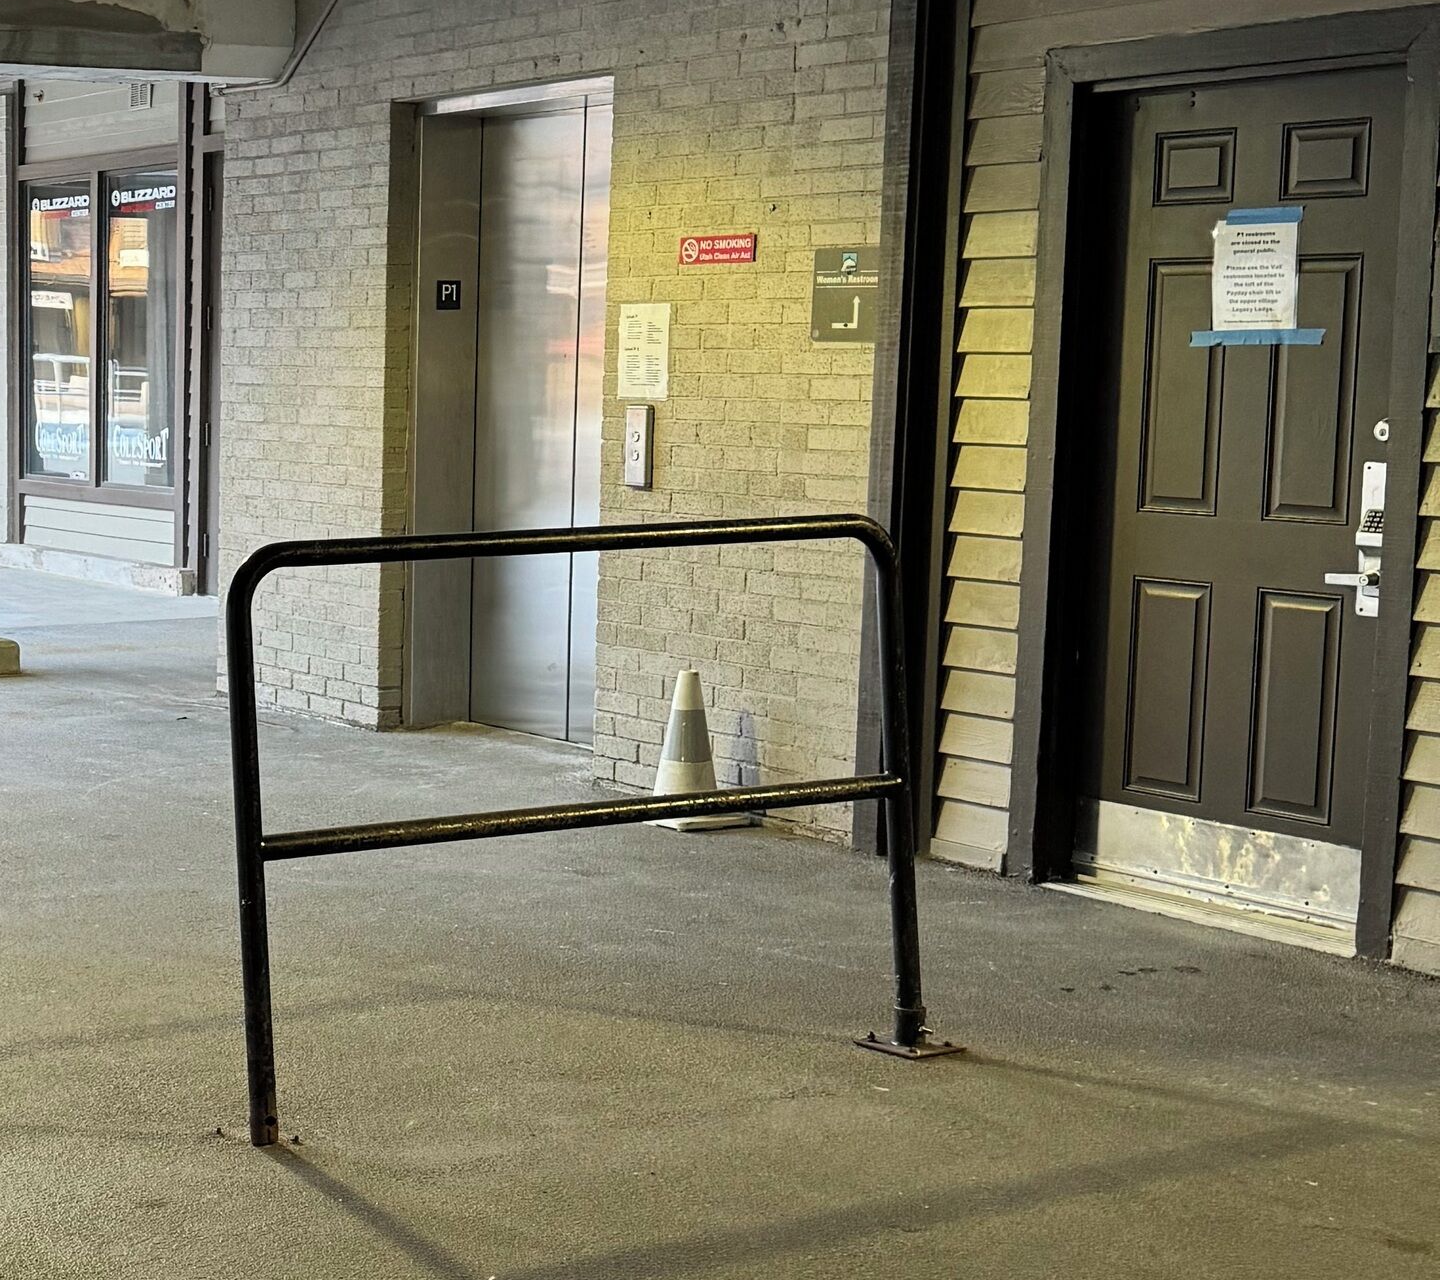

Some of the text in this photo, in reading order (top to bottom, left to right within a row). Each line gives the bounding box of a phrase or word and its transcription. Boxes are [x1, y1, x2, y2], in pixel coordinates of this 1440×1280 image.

[120, 185, 176, 204] BLIZZARD
[40, 195, 90, 211] BLIZZARD
[699, 238, 751, 250] NO SMOKING
[699, 252, 713, 261] Utah
[442, 284, 457, 301] P1
